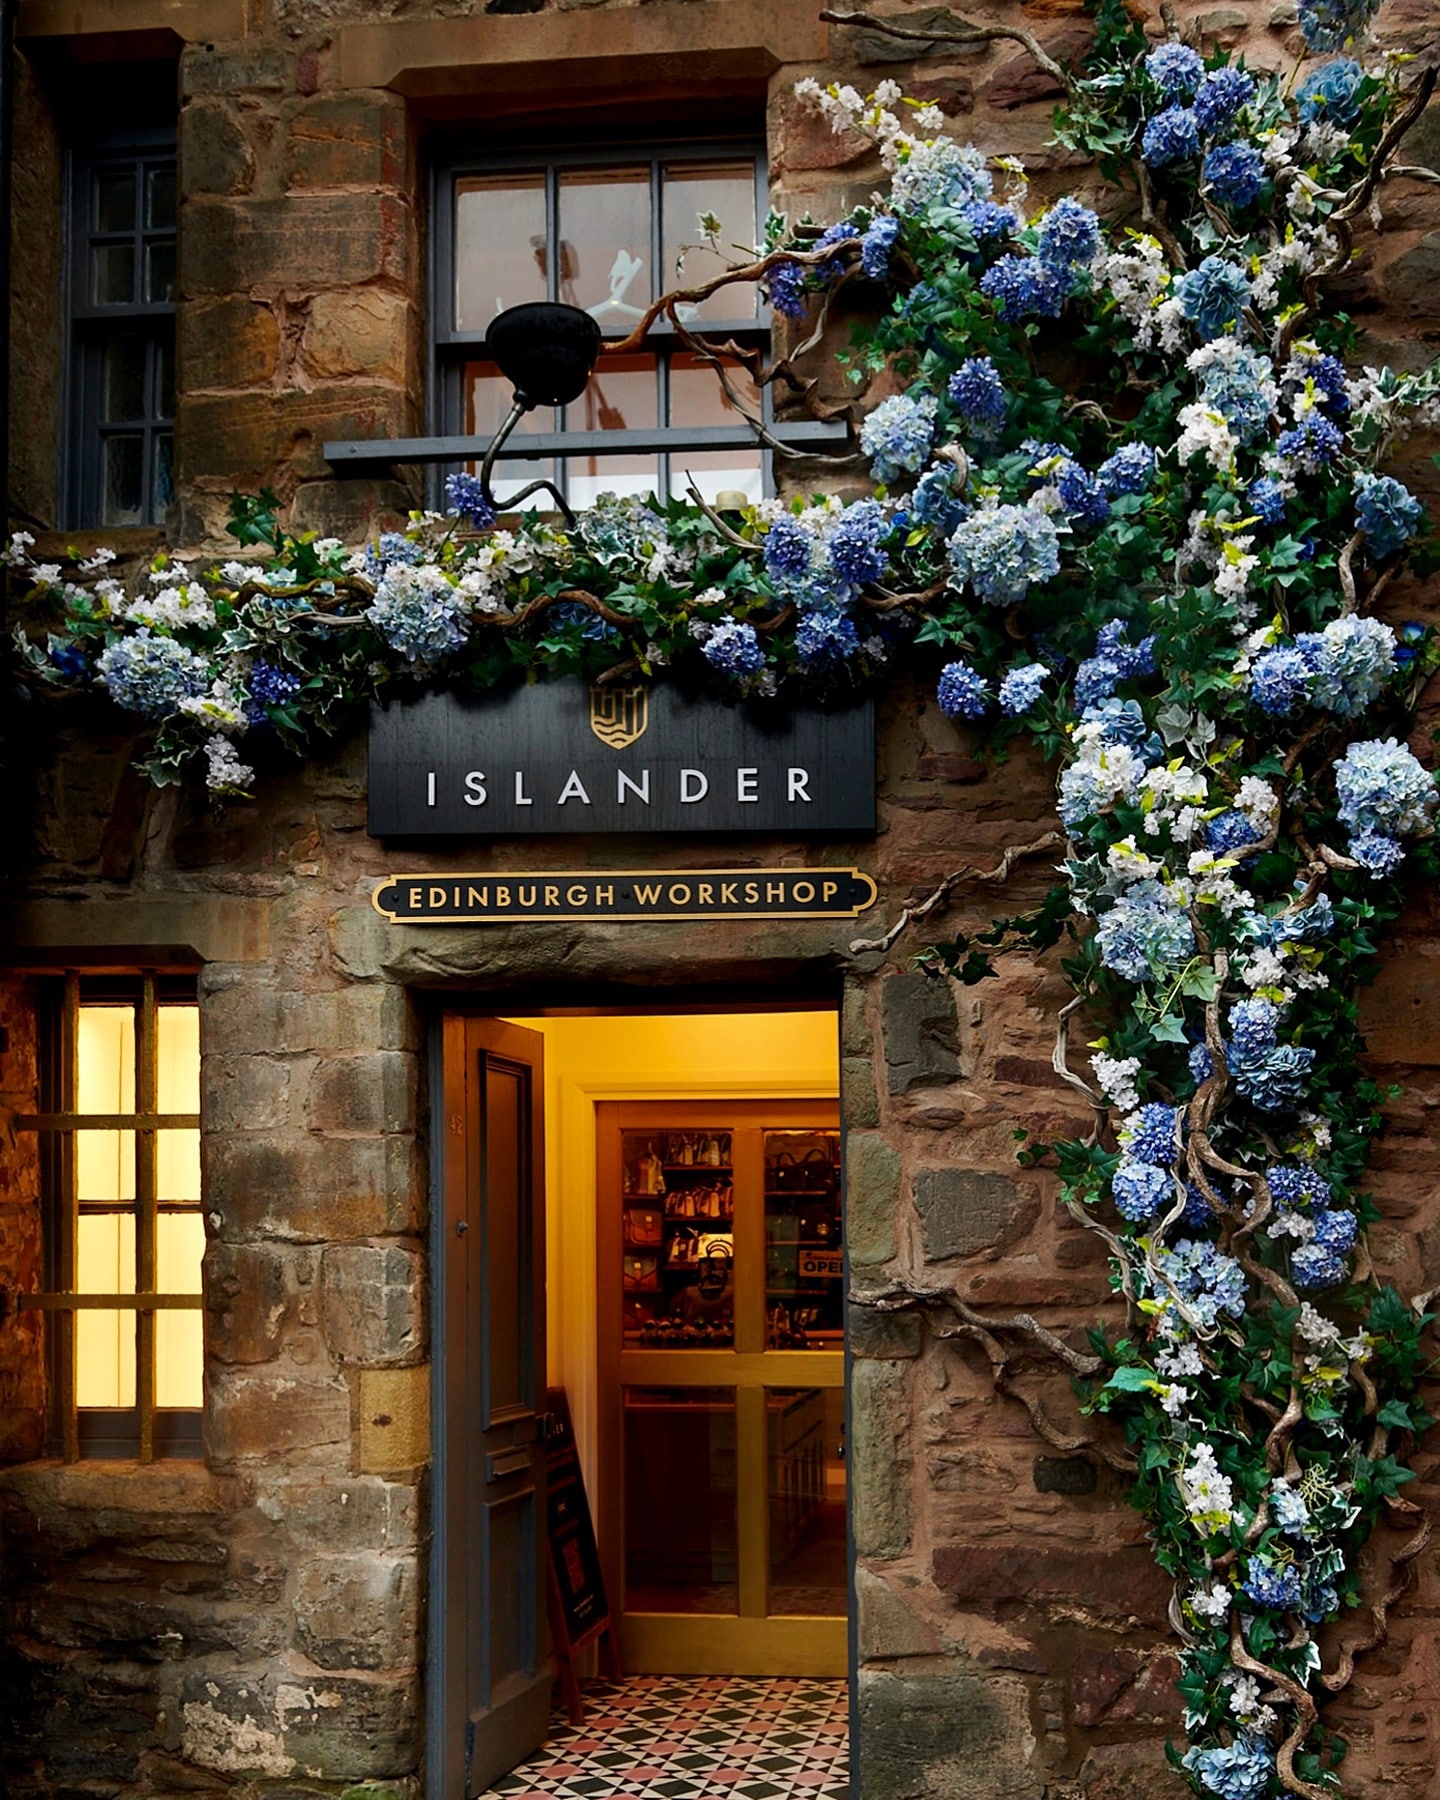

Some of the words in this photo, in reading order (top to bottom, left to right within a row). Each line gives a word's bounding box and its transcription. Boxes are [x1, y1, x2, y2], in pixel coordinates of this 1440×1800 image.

[427, 767, 813, 807] ISLANDER
[408, 884, 615, 910] EDINBURGH
[633, 881, 839, 906] WORKSHOP
[803, 1260, 843, 1273] OPE
